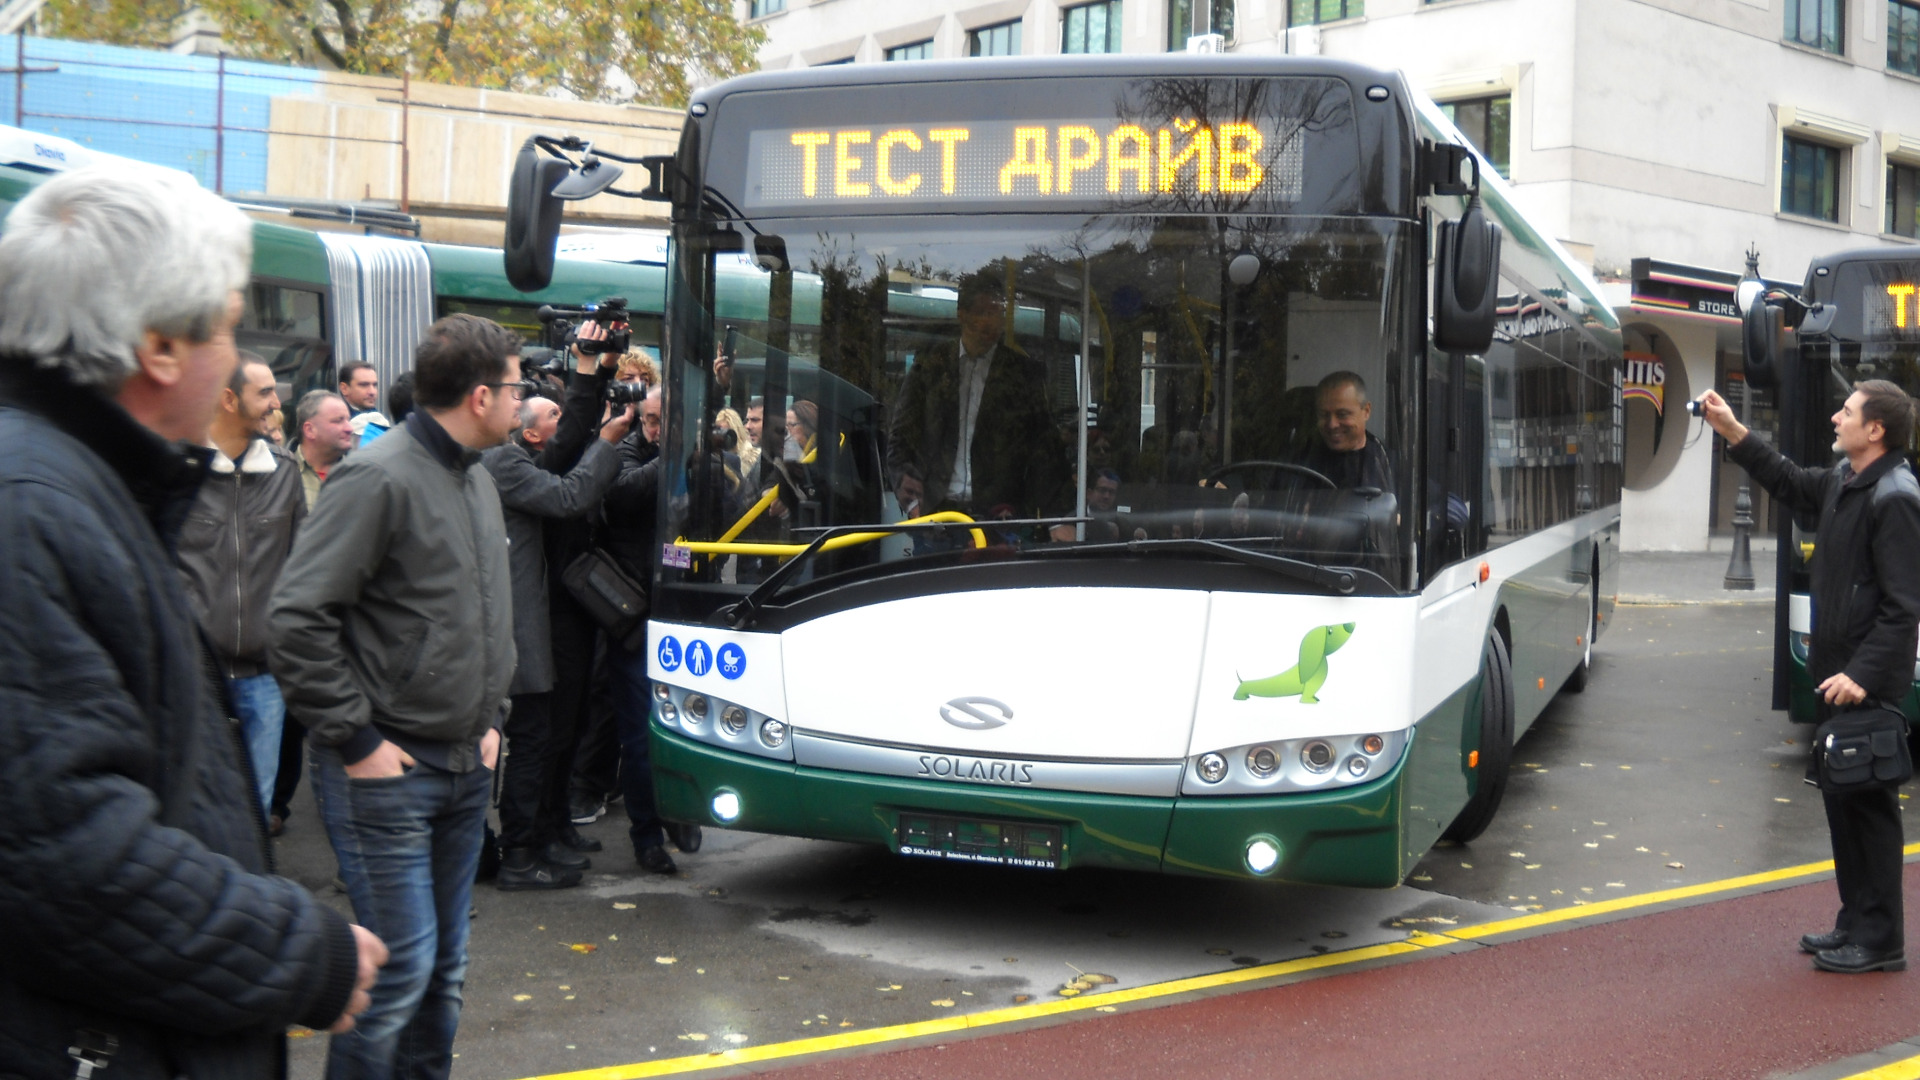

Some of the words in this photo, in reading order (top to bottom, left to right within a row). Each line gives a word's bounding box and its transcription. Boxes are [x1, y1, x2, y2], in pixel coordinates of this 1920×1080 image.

[790, 127, 970, 198] ТЕСТ
[999, 116, 1264, 195] ДРАЙВ
[1698, 300, 1736, 316] STORE
[1886, 283, 1920, 328] Т
[1623, 359, 1665, 386] ITIS
[917, 755, 1034, 785] SOLARIS
[913, 848, 942, 857] SOLARIS
